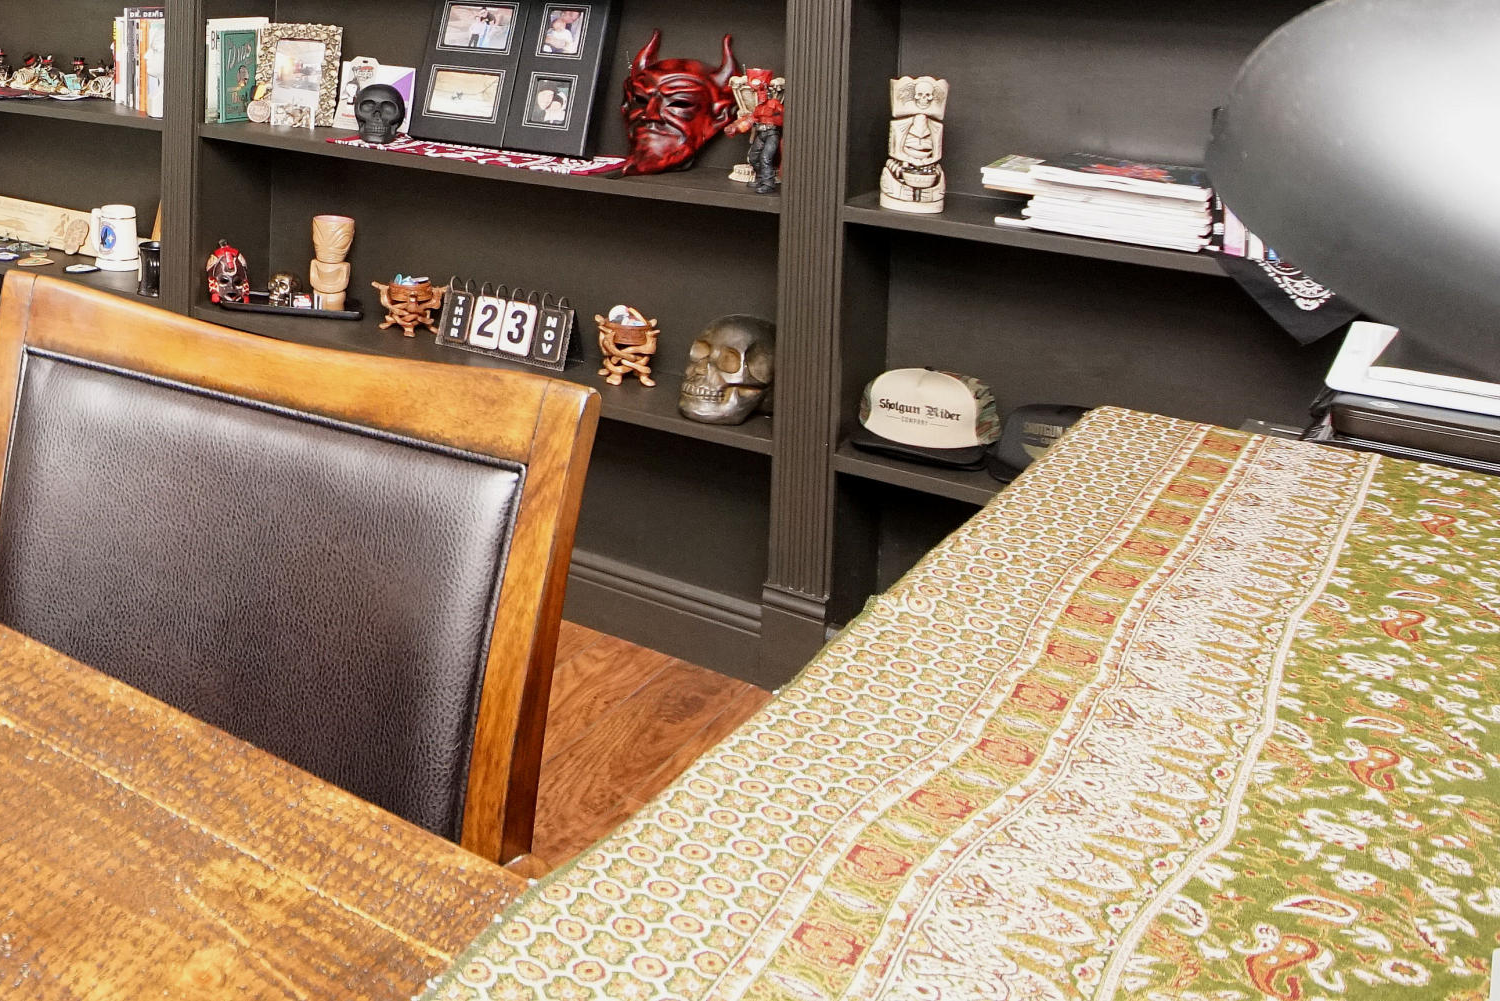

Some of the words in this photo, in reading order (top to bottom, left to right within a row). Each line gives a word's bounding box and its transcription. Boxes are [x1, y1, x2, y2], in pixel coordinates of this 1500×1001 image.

[450, 296, 465, 338] THUR
[542, 316, 557, 354] NOV
[879, 398, 920, 415] Shotgun
[925, 406, 961, 421] Rider
[1022, 422, 1063, 438] SHOTGUN
